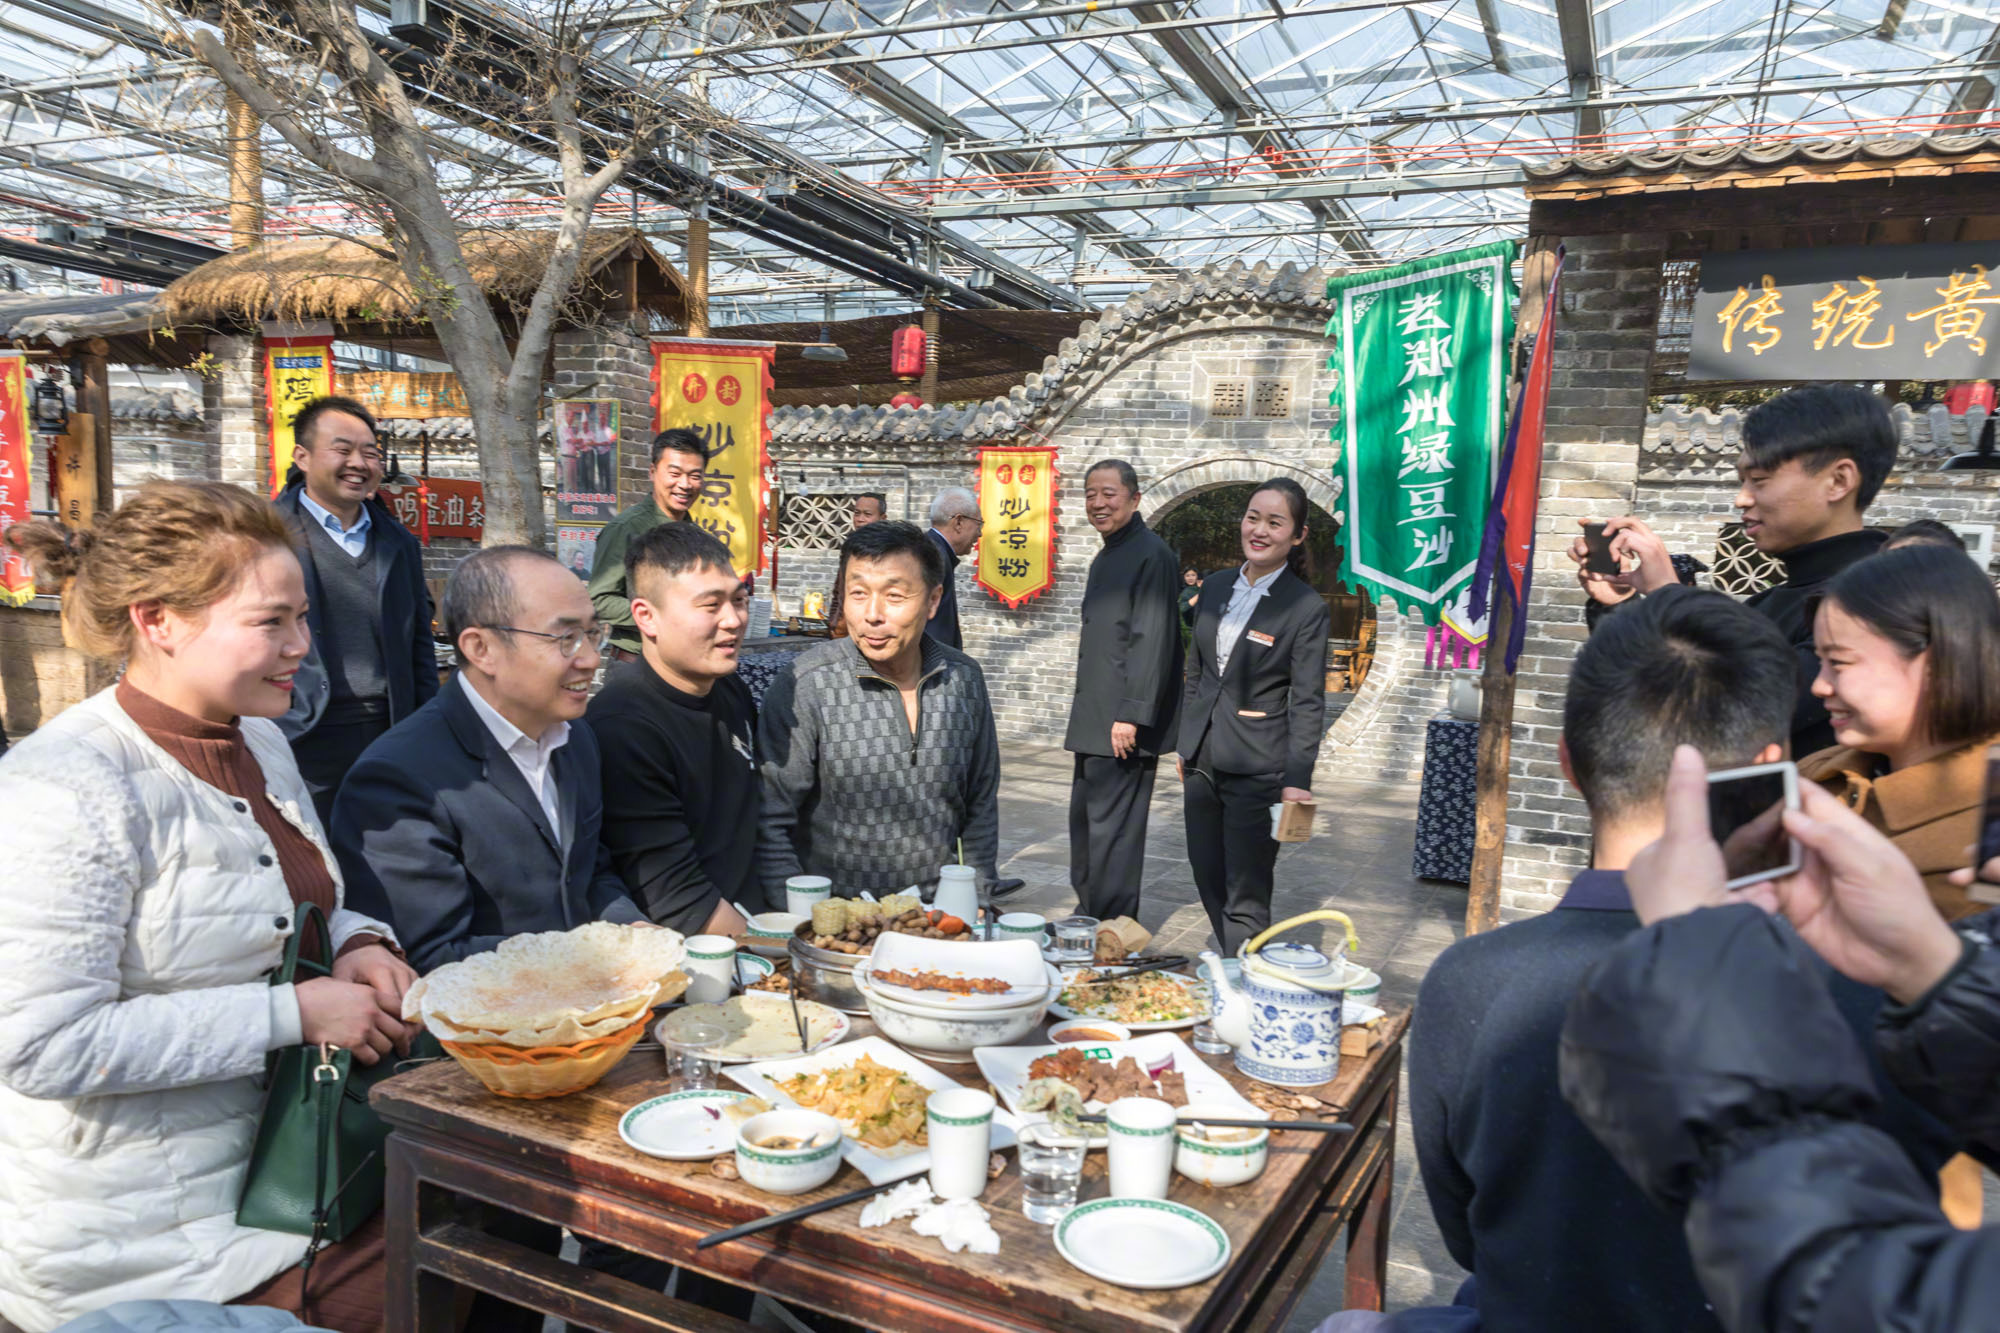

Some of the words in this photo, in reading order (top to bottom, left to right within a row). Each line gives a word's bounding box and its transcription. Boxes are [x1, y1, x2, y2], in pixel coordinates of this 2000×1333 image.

[1717, 264, 2000, 358] 传统黄
[685, 376, 738, 402] 开封
[1396, 289, 1457, 572] 老郑州绿豆沙
[997, 465, 1036, 483] 开封
[393, 491, 485, 527] 鸡蛋油条
[998, 497, 1031, 578] 炒凉粉
